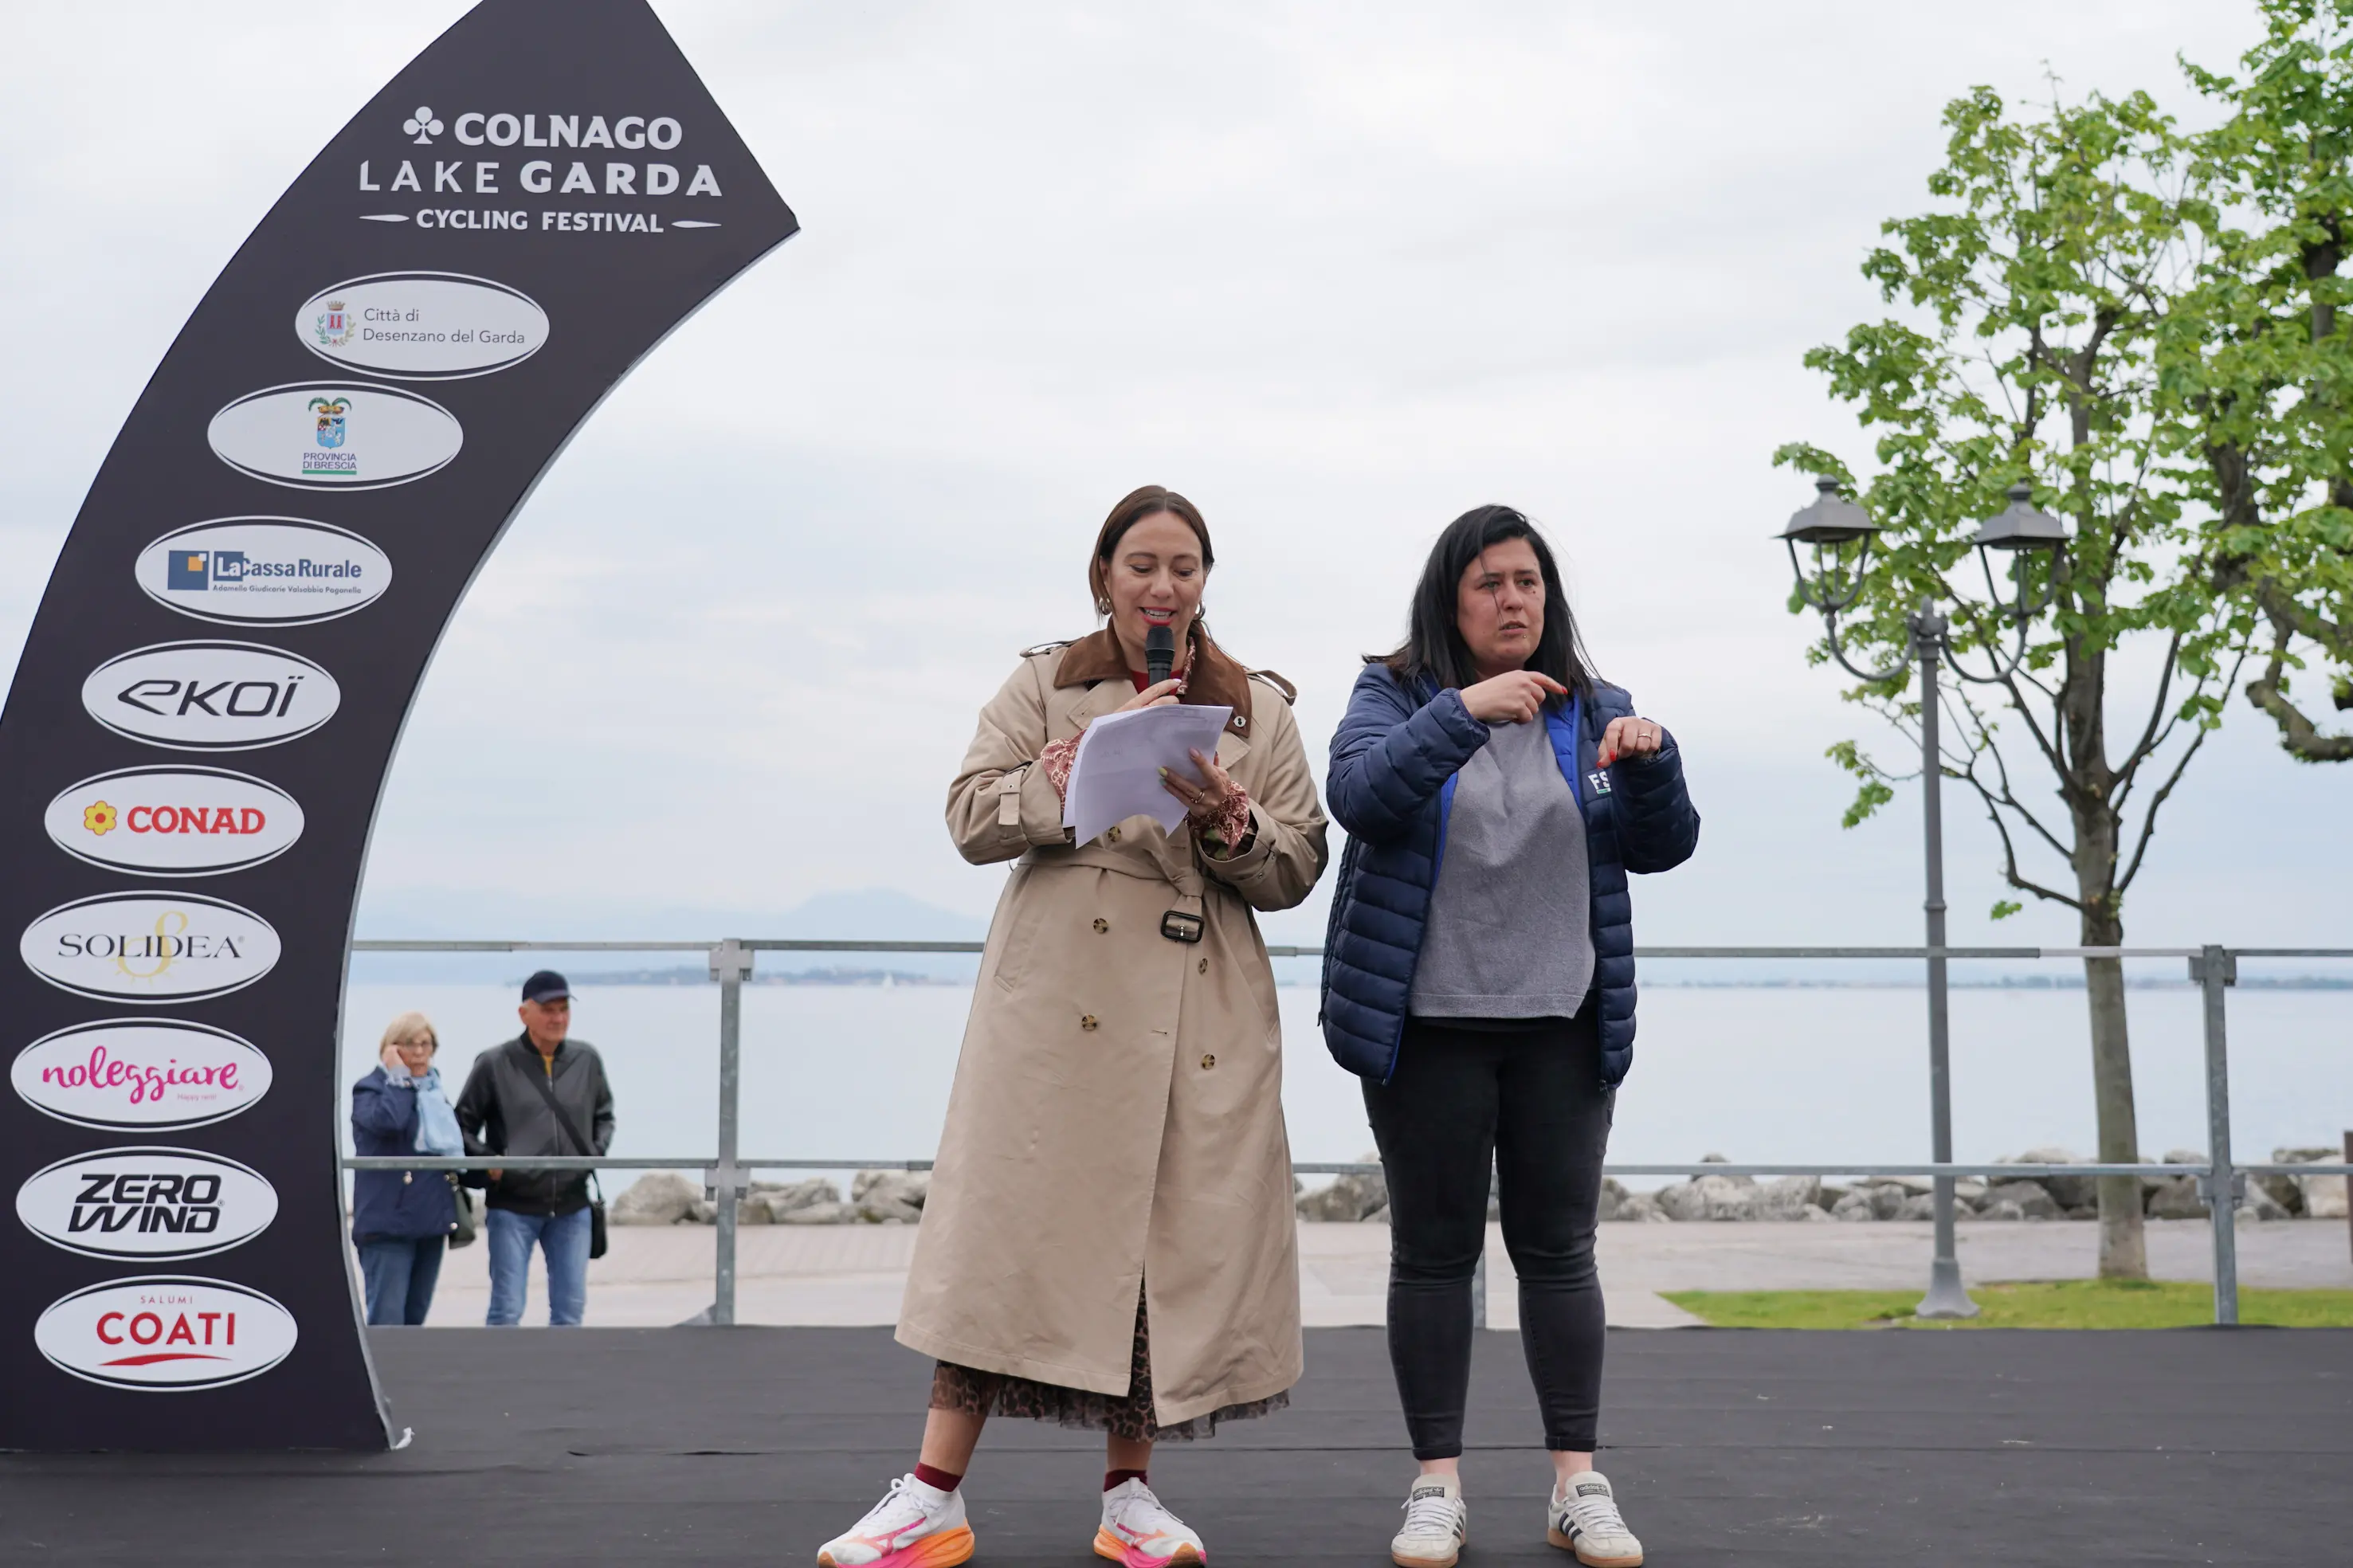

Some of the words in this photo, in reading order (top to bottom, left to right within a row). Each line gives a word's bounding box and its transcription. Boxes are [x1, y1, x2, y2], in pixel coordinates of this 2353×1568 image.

[455, 112, 682, 150] COLNAGO
[360, 160, 499, 193] LAKE
[520, 161, 722, 196] GARDA
[417, 209, 527, 229] CYCLING
[543, 212, 664, 233] FESTIVAL
[364, 308, 399, 321] Città
[406, 309, 418, 321] di
[363, 328, 445, 342] Desenzano
[451, 330, 473, 342] del
[480, 331, 524, 343] Garda
[304, 453, 356, 461] PROVINCIA
[326, 586, 361, 595] Paganella
[127, 806, 265, 834] CONAD
[58, 935, 241, 958] SOLIDEA
[42, 1045, 238, 1104] noleggiare
[75, 1174, 222, 1204] ZERO
[68, 1205, 220, 1233] WIND
[139, 1296, 194, 1304] SALUMI
[96, 1312, 235, 1345] COATI
